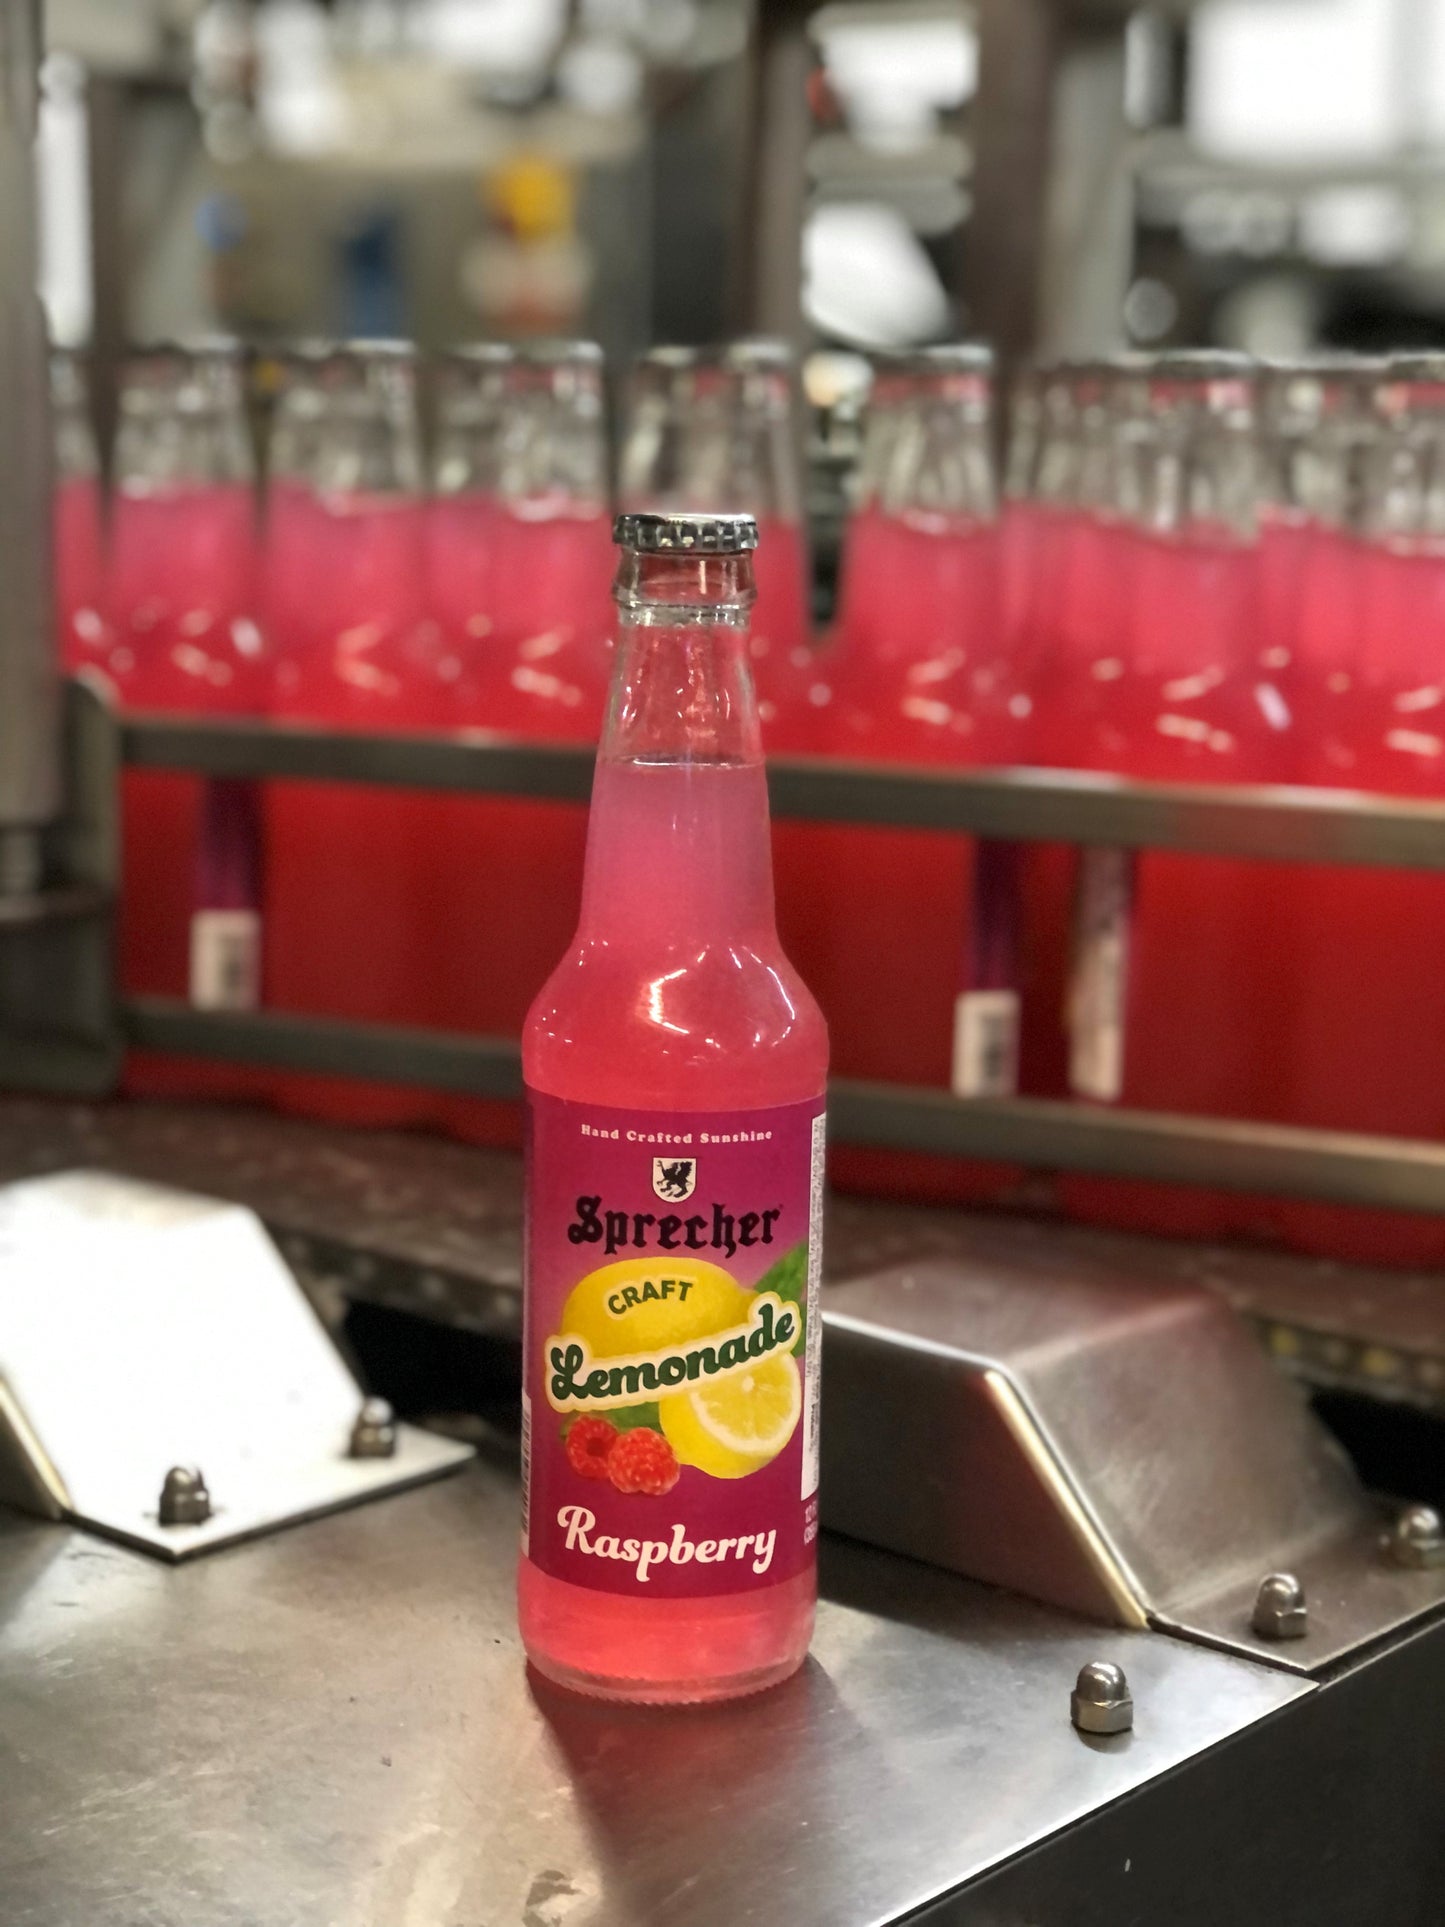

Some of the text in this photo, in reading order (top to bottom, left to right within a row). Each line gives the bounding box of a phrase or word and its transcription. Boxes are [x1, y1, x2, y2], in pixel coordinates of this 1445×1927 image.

[581, 1124, 773, 1144] Hand Crafted Sunshine
[567, 1195, 780, 1258] Sprecher
[608, 1280, 693, 1315] CRAFT
[550, 1303, 795, 1400] Lemonade
[557, 1505, 777, 1582] Raspberry
